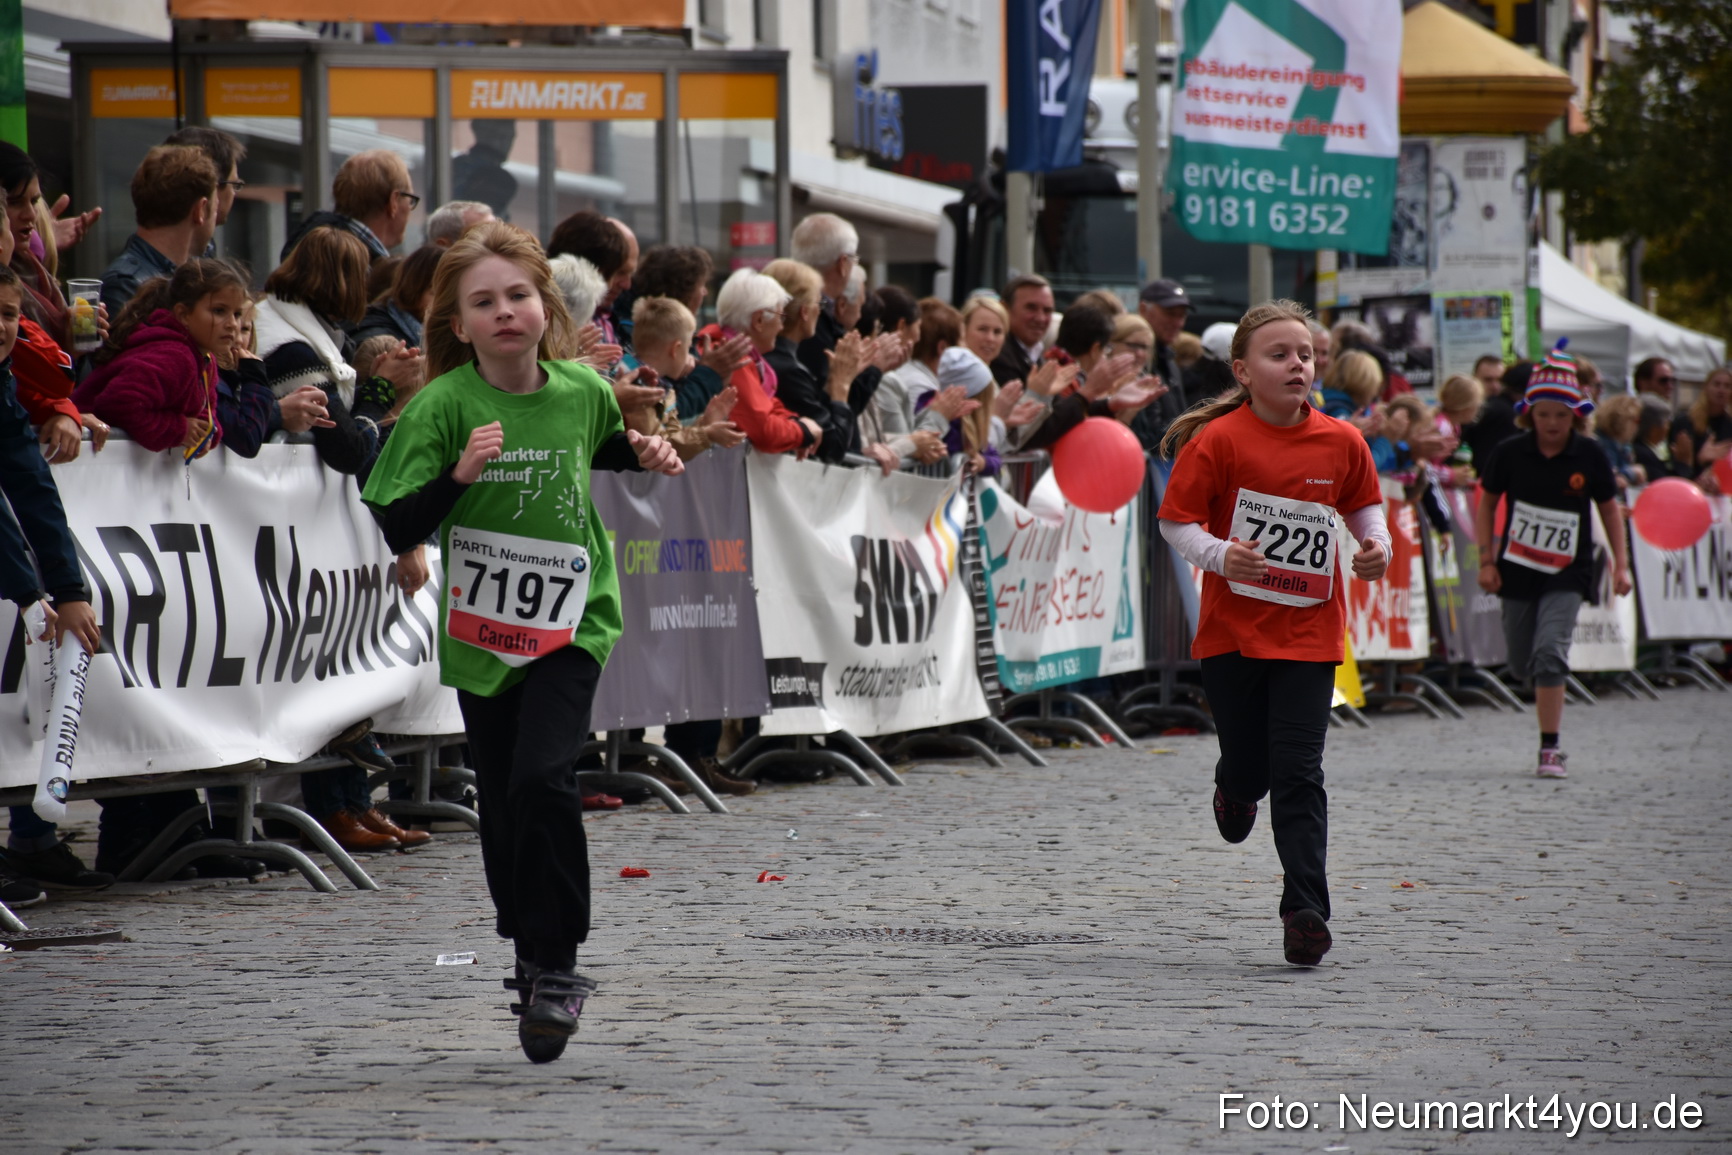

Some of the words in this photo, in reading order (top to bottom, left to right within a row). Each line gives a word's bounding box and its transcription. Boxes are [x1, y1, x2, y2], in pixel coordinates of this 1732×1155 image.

[1183, 158, 1375, 199] ervice-Line:
[1184, 193, 1256, 227] 9181
[1268, 202, 1349, 235] 6352
[1238, 499, 1276, 517] PARTL
[1279, 508, 1326, 525] Neumarkt
[452, 539, 497, 558] PARTL
[500, 547, 566, 569] Neumarkt
[1246, 516, 1329, 569] 7228
[1518, 517, 1571, 552] 7178
[464, 559, 575, 623] 7197
[1253, 573, 1308, 593] ariella
[1, 523, 246, 695] ARTL
[254, 525, 441, 684] Neumar
[478, 624, 539, 653] Carolin
[55, 713, 80, 771] BMW
